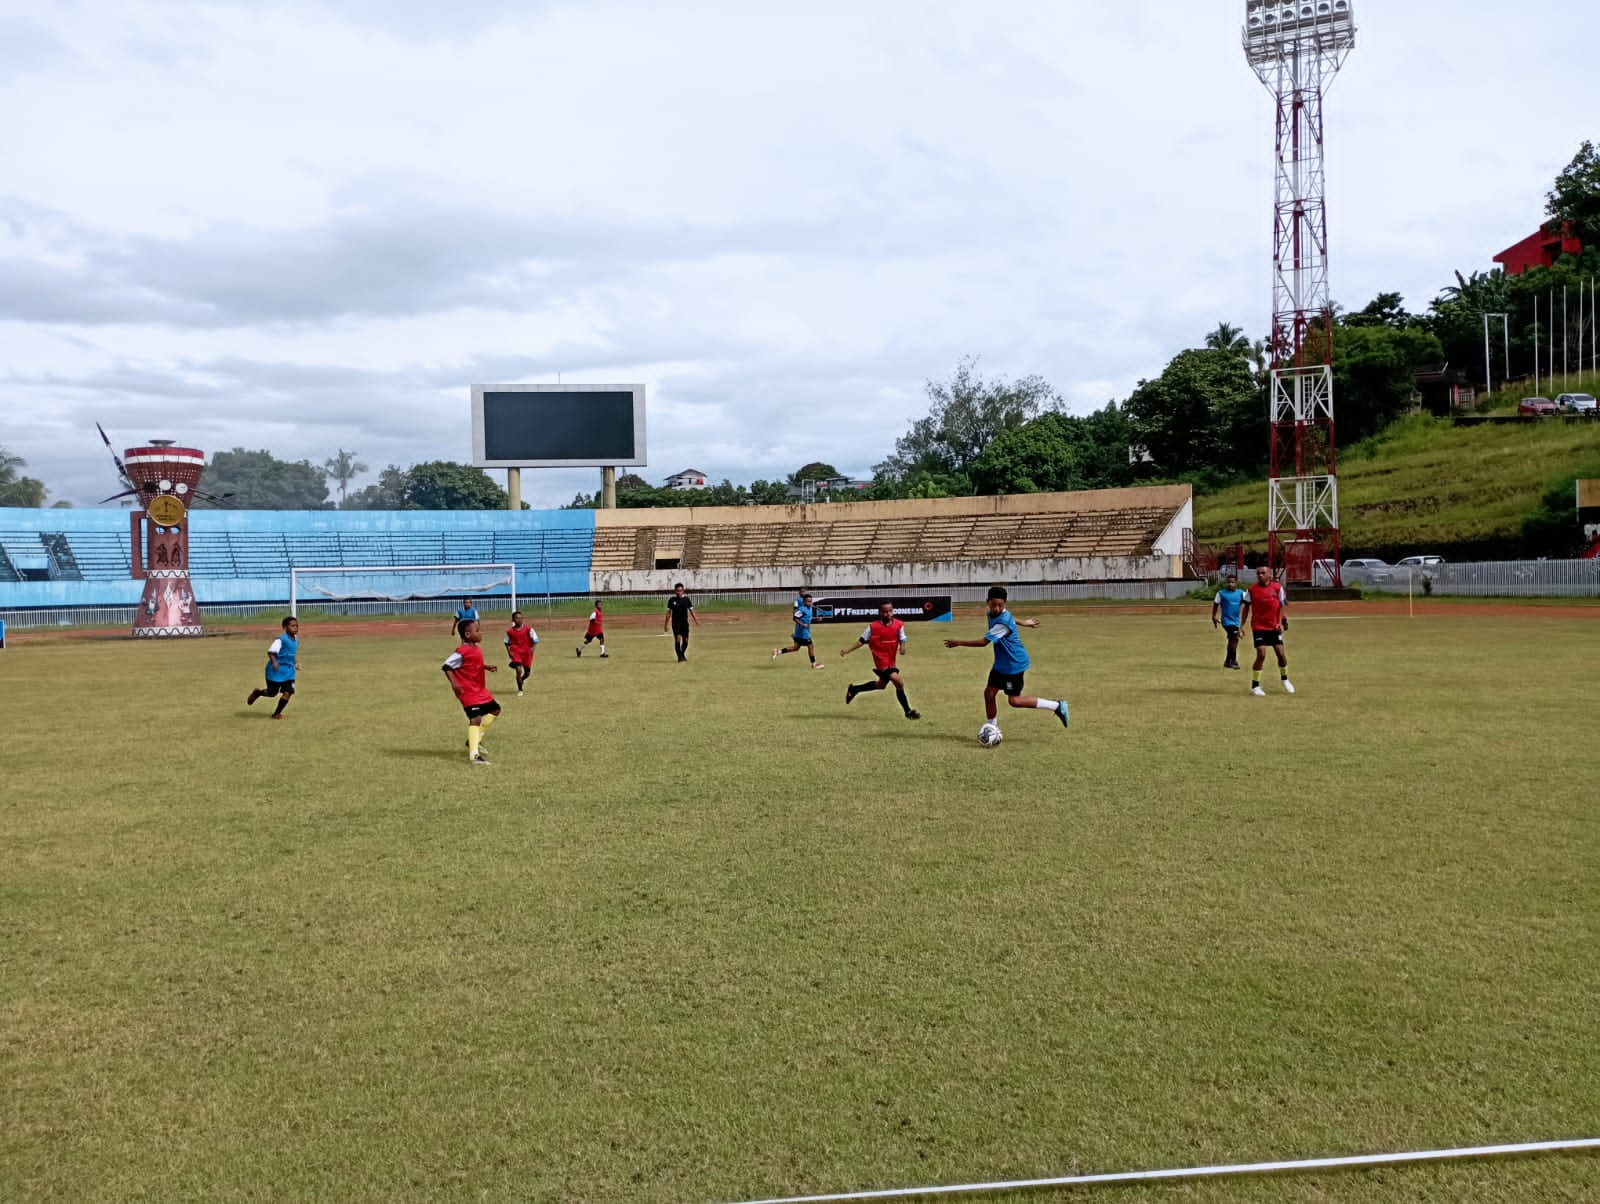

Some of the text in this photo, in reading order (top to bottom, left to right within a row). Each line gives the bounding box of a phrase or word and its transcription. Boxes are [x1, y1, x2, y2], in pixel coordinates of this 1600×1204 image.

[834, 607, 924, 616] PT FREEPOR DONESIA
